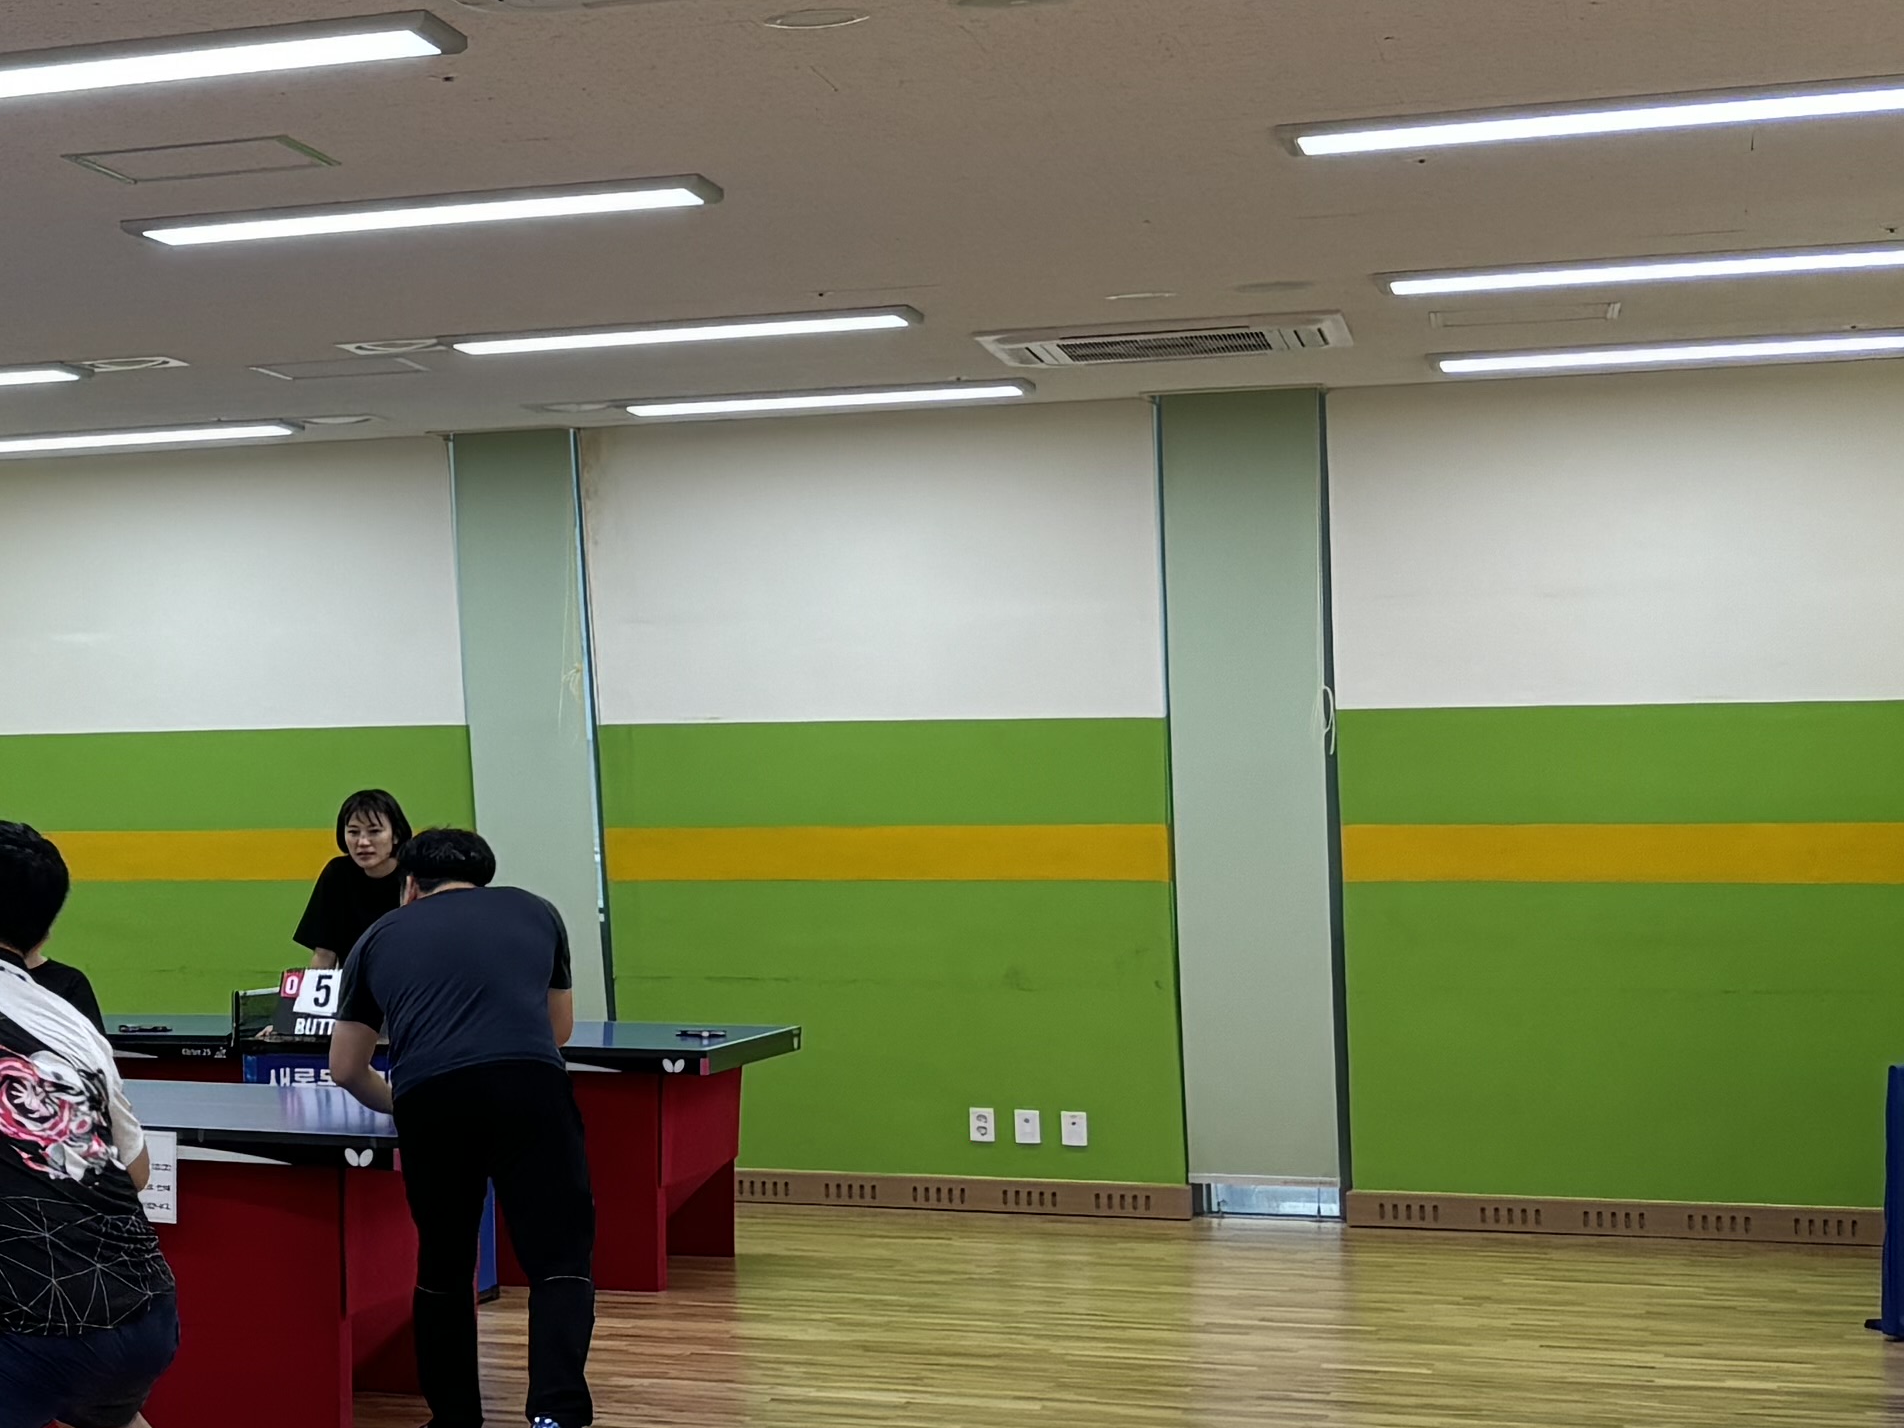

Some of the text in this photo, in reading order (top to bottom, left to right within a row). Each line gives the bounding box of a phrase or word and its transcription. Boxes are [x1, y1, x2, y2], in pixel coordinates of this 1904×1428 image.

[285, 974, 333, 1008] 0 5
[294, 1017, 336, 1035] BUTT
